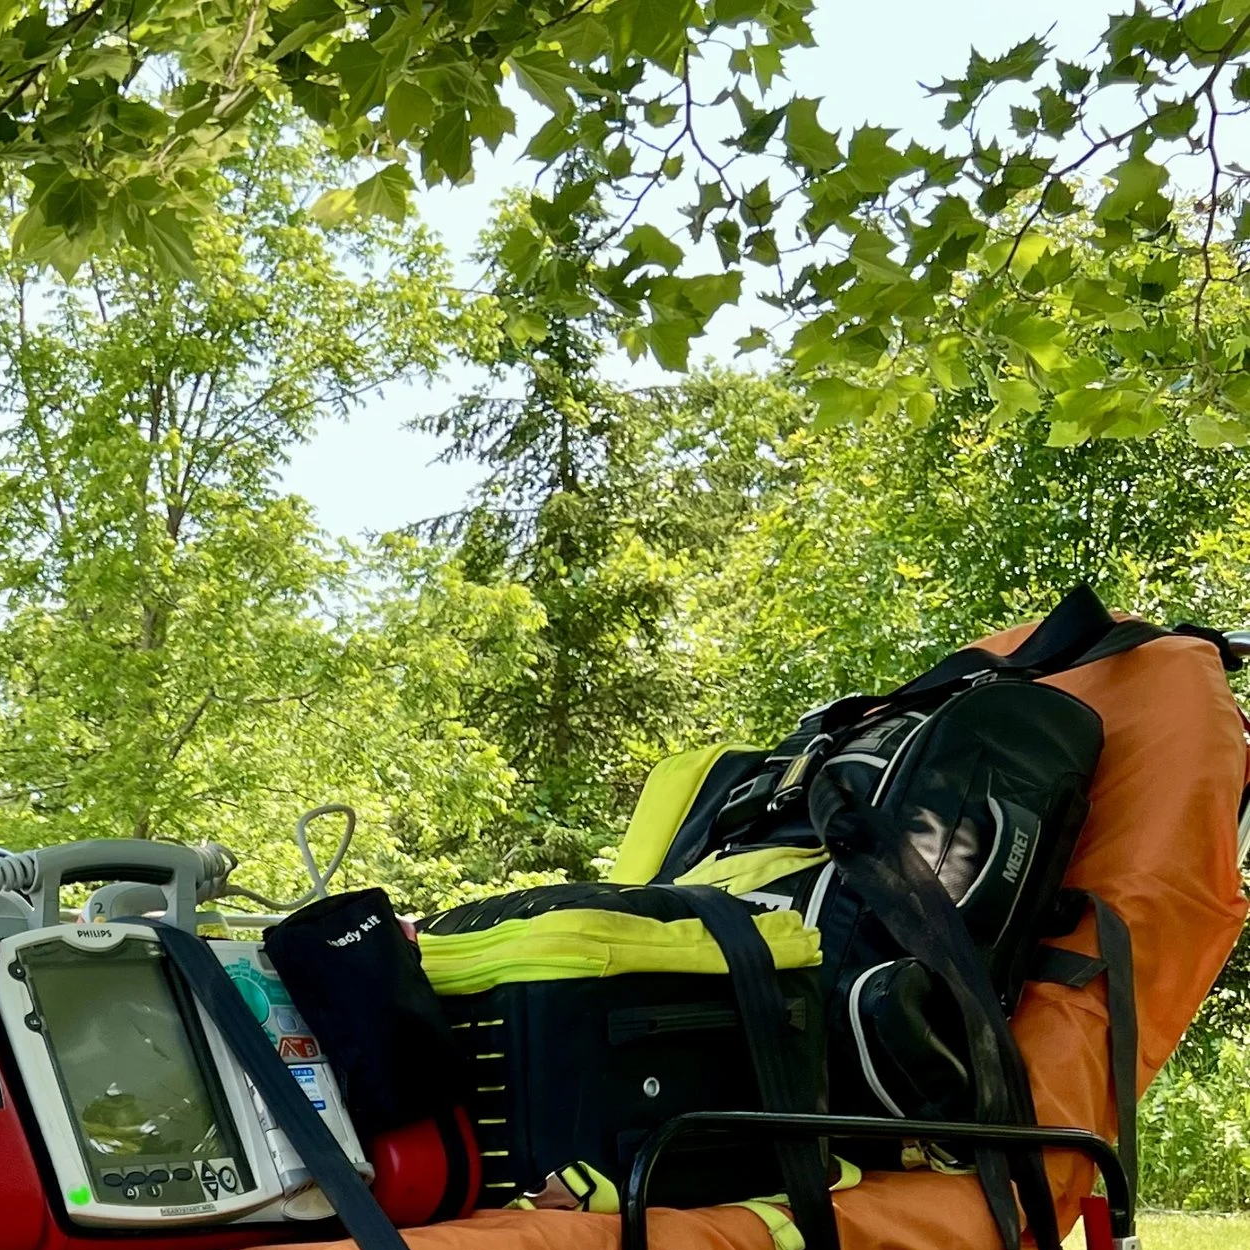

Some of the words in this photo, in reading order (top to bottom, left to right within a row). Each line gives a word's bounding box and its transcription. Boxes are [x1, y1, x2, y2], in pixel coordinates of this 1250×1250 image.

[1002, 827, 1029, 883] MERET
[94, 902, 106, 914] 2
[359, 915, 382, 932] kit
[76, 929, 113, 939] PHILIPS
